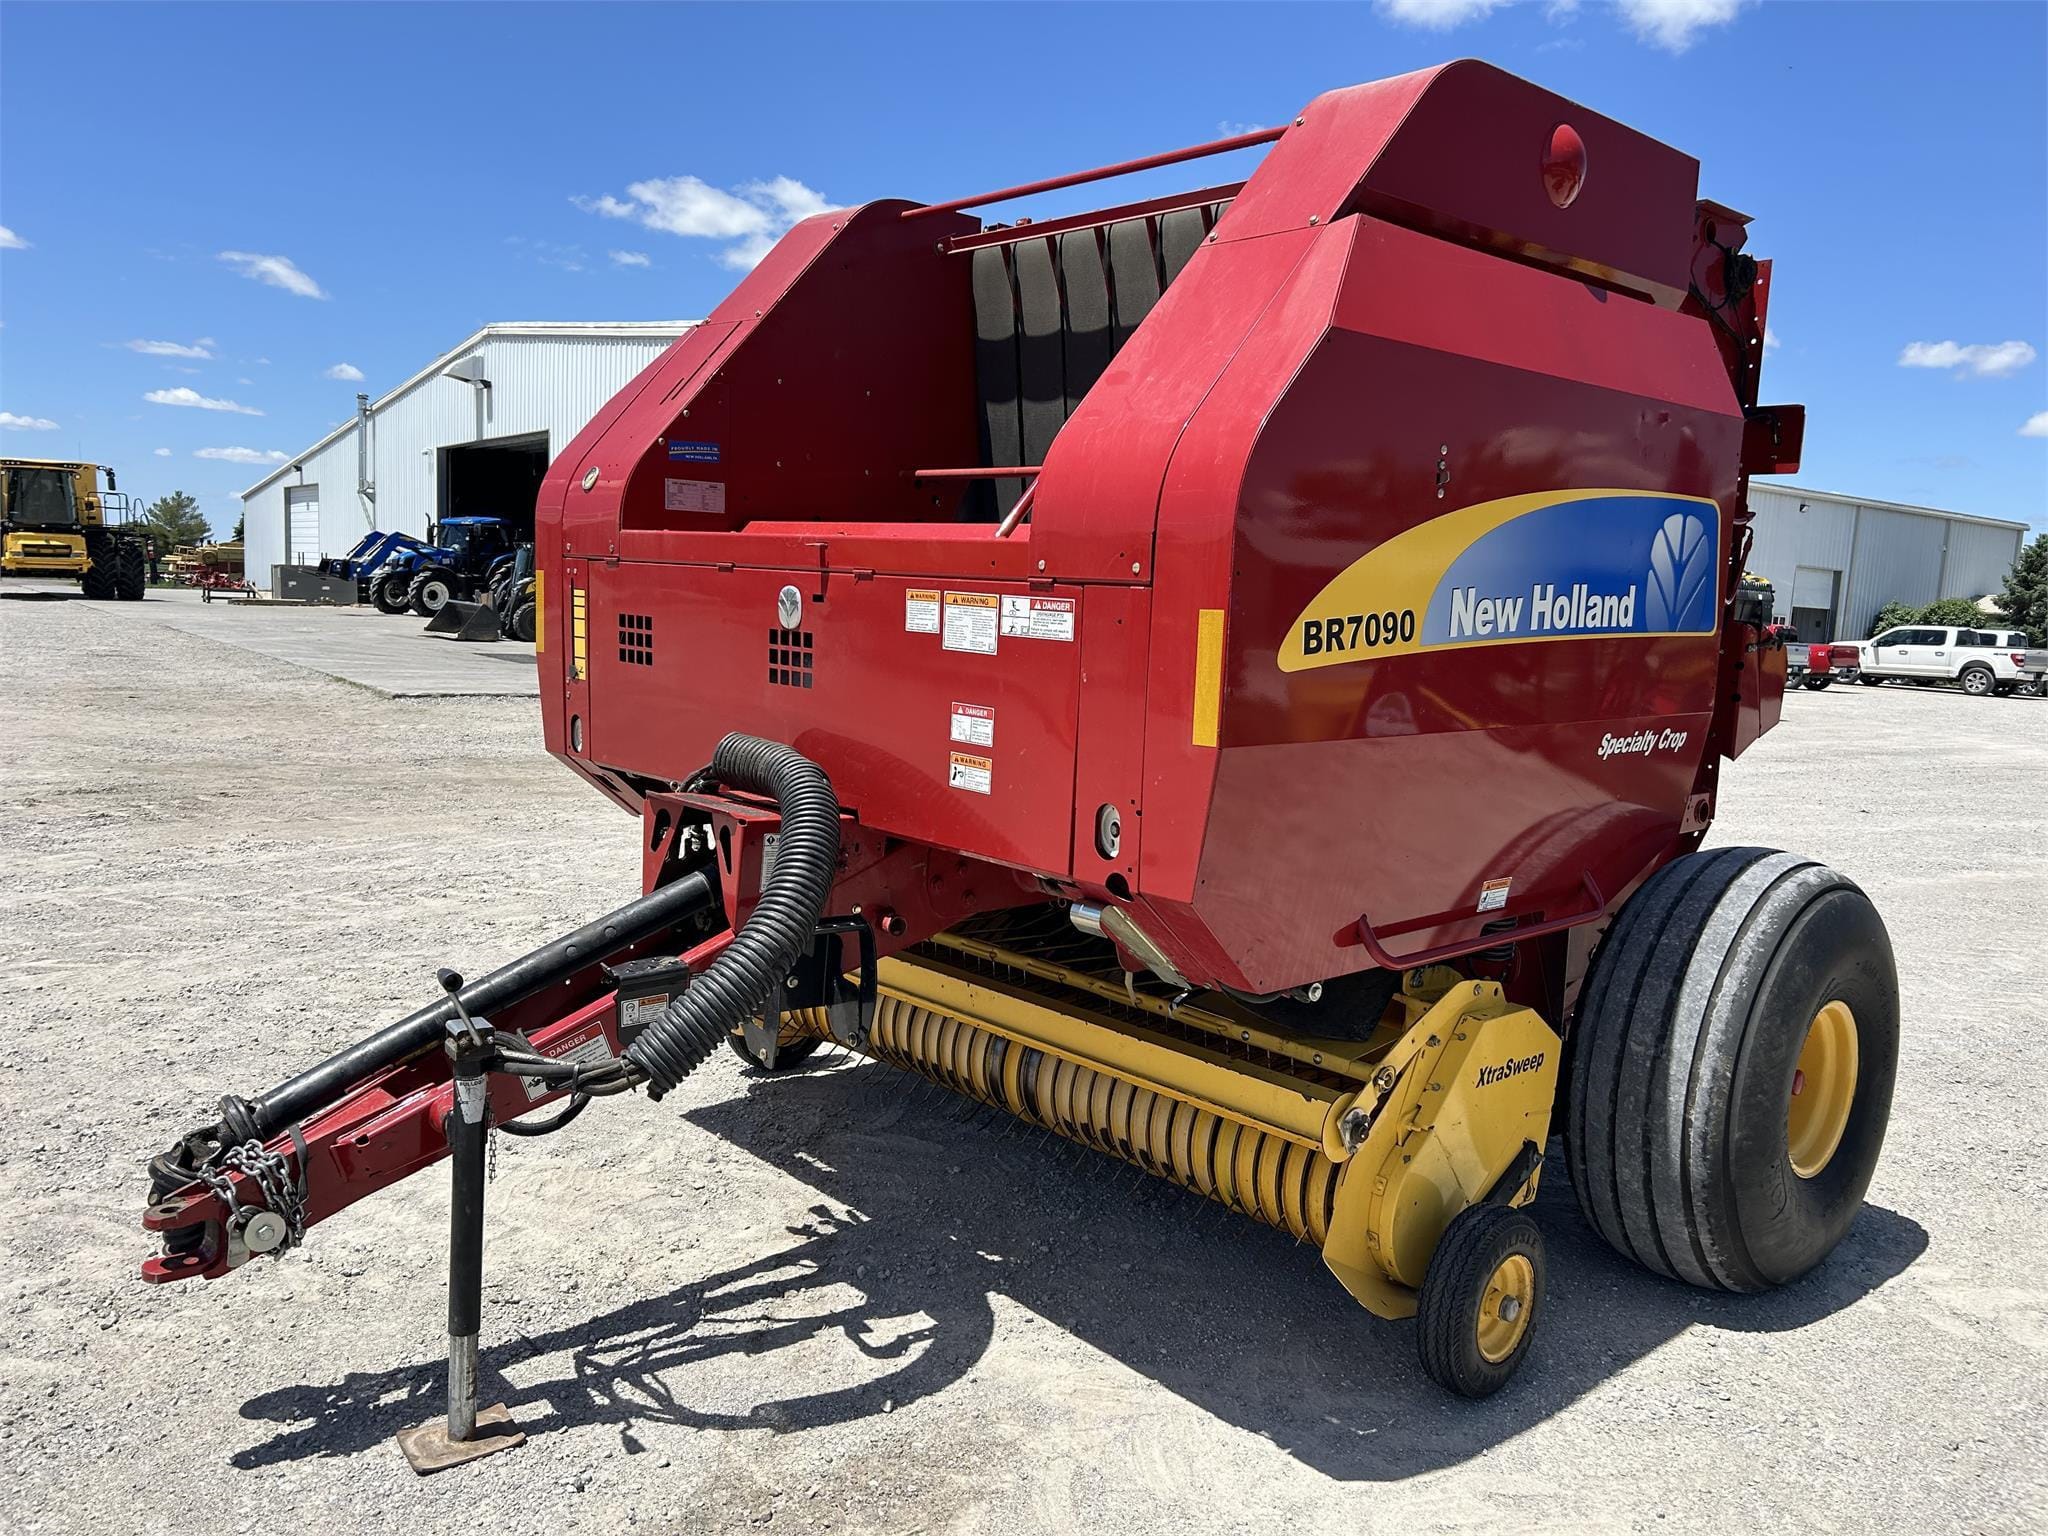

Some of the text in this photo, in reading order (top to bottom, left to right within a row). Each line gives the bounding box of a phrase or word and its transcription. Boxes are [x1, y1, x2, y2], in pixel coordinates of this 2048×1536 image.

[960, 596, 989, 605] WARNING
[1042, 601, 1070, 611] DANGER
[1449, 583, 1636, 638] New Holland
[1303, 609, 1415, 656] BR7090
[965, 707, 988, 717] DANGER
[1597, 727, 1688, 761] Specialty Crop
[960, 757, 987, 768] WARNING
[548, 1034, 587, 1057] DANGER
[1475, 1052, 1545, 1089] XtraSweep
